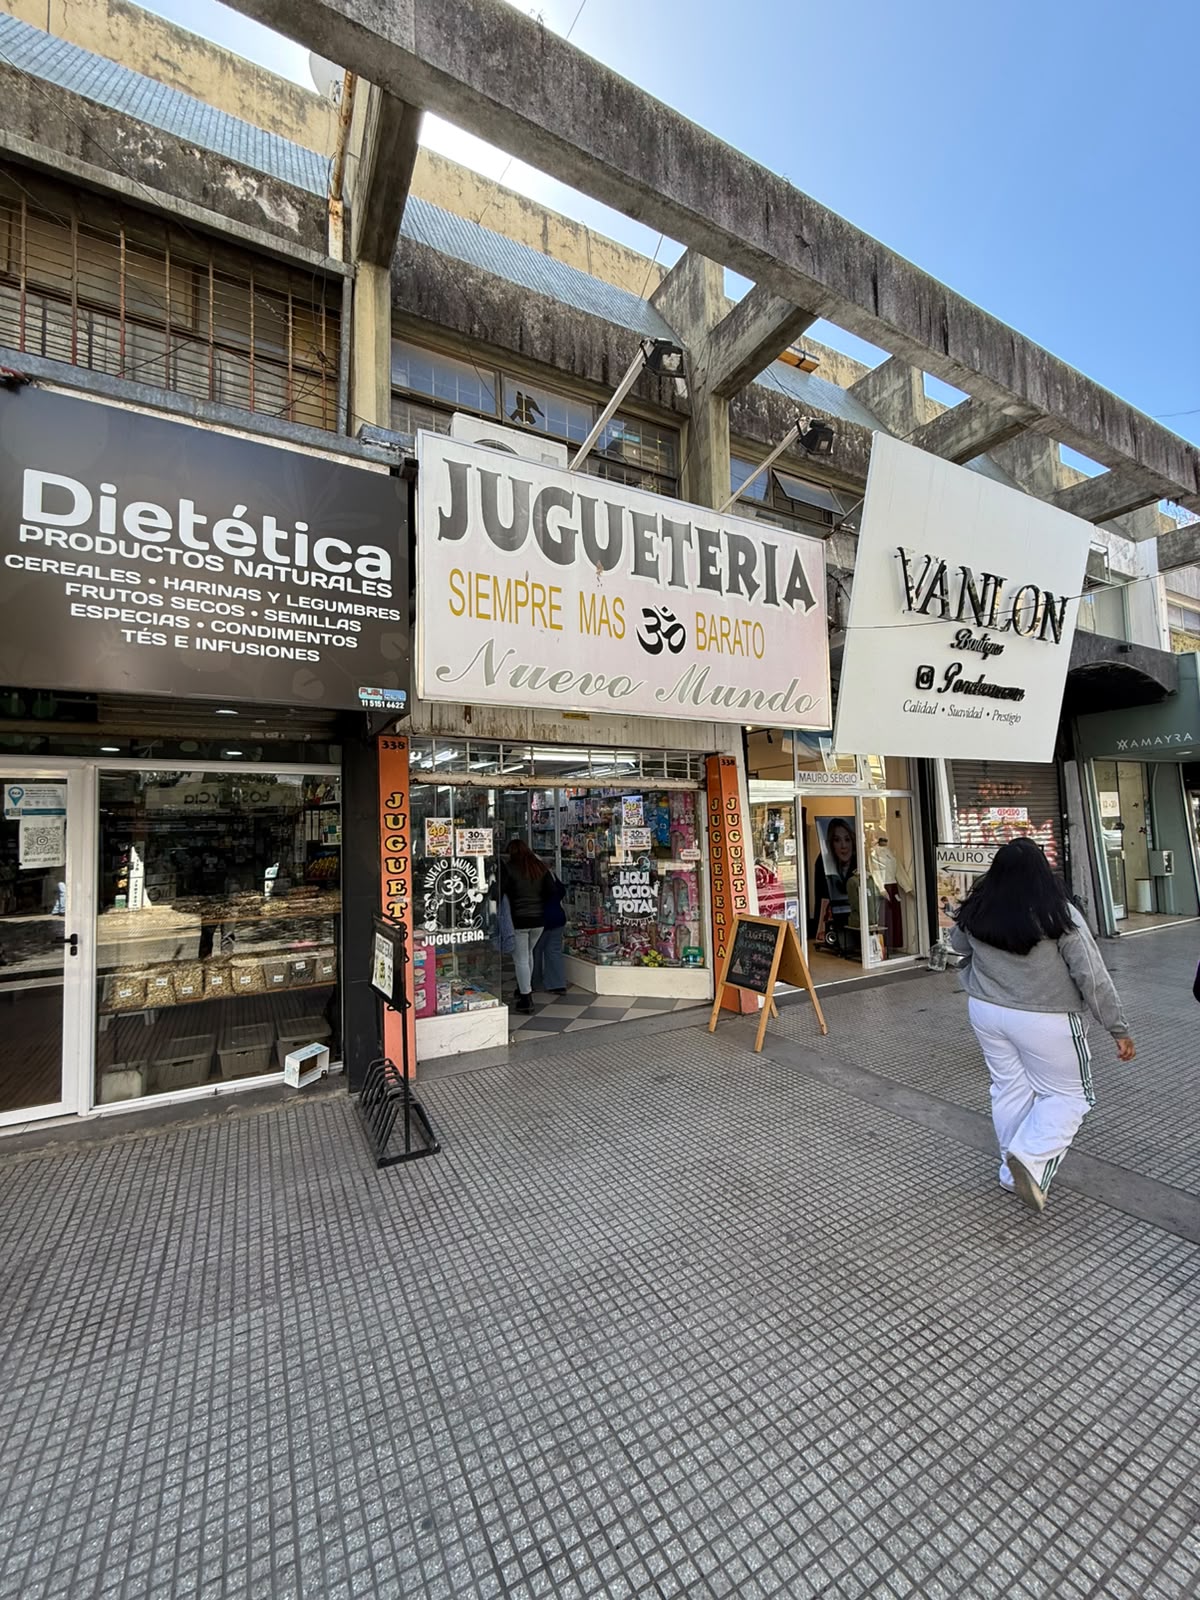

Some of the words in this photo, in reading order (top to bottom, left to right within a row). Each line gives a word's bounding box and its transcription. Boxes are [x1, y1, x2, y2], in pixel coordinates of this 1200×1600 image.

[22, 468, 392, 580] Dietética
[438, 458, 817, 613] JUGUETERIA
[20, 524, 225, 572] PRODUCTOS
[234, 561, 393, 599] NATURALES
[5, 554, 141, 585] CEREALES
[164, 576, 262, 602] HARINAS
[267, 592, 283, 604] Y
[287, 593, 401, 621] LEGUMBRES
[65, 582, 163, 606] FRUTOS
[171, 597, 245, 617] SECOS
[264, 609, 362, 633] SEMILLAS
[895, 547, 1069, 644] VANLON
[71, 603, 190, 629] ESPECIAS
[211, 620, 358, 648] CONDIMENTOS
[448, 568, 563, 631] SIEMPRE
[579, 591, 626, 639] MAS
[695, 612, 765, 659] BARATO
[121, 627, 167, 646] TÉS
[175, 635, 190, 649] E
[196, 637, 320, 662] INFUSIONES
[436, 638, 648, 696] Nuevo
[655, 664, 821, 714] Mundo
[903, 699, 938, 714] Calidad
[948, 705, 984, 719] Suavidad
[992, 709, 1021, 726] Prestigio
[382, 740, 405, 749] 338
[798, 772, 828, 783] MAURO
[830, 773, 857, 784] SERGIO
[424, 859, 449, 888] NUEVO
[451, 857, 479, 884] MUNDO
[620, 871, 650, 885] LIQUI
[711, 797, 726, 958] JUGUETERIA
[937, 852, 984, 864] MAURO
[612, 884, 659, 899] DACION
[616, 898, 657, 913] TOTAL
[421, 929, 484, 947] JUGUETERIA
